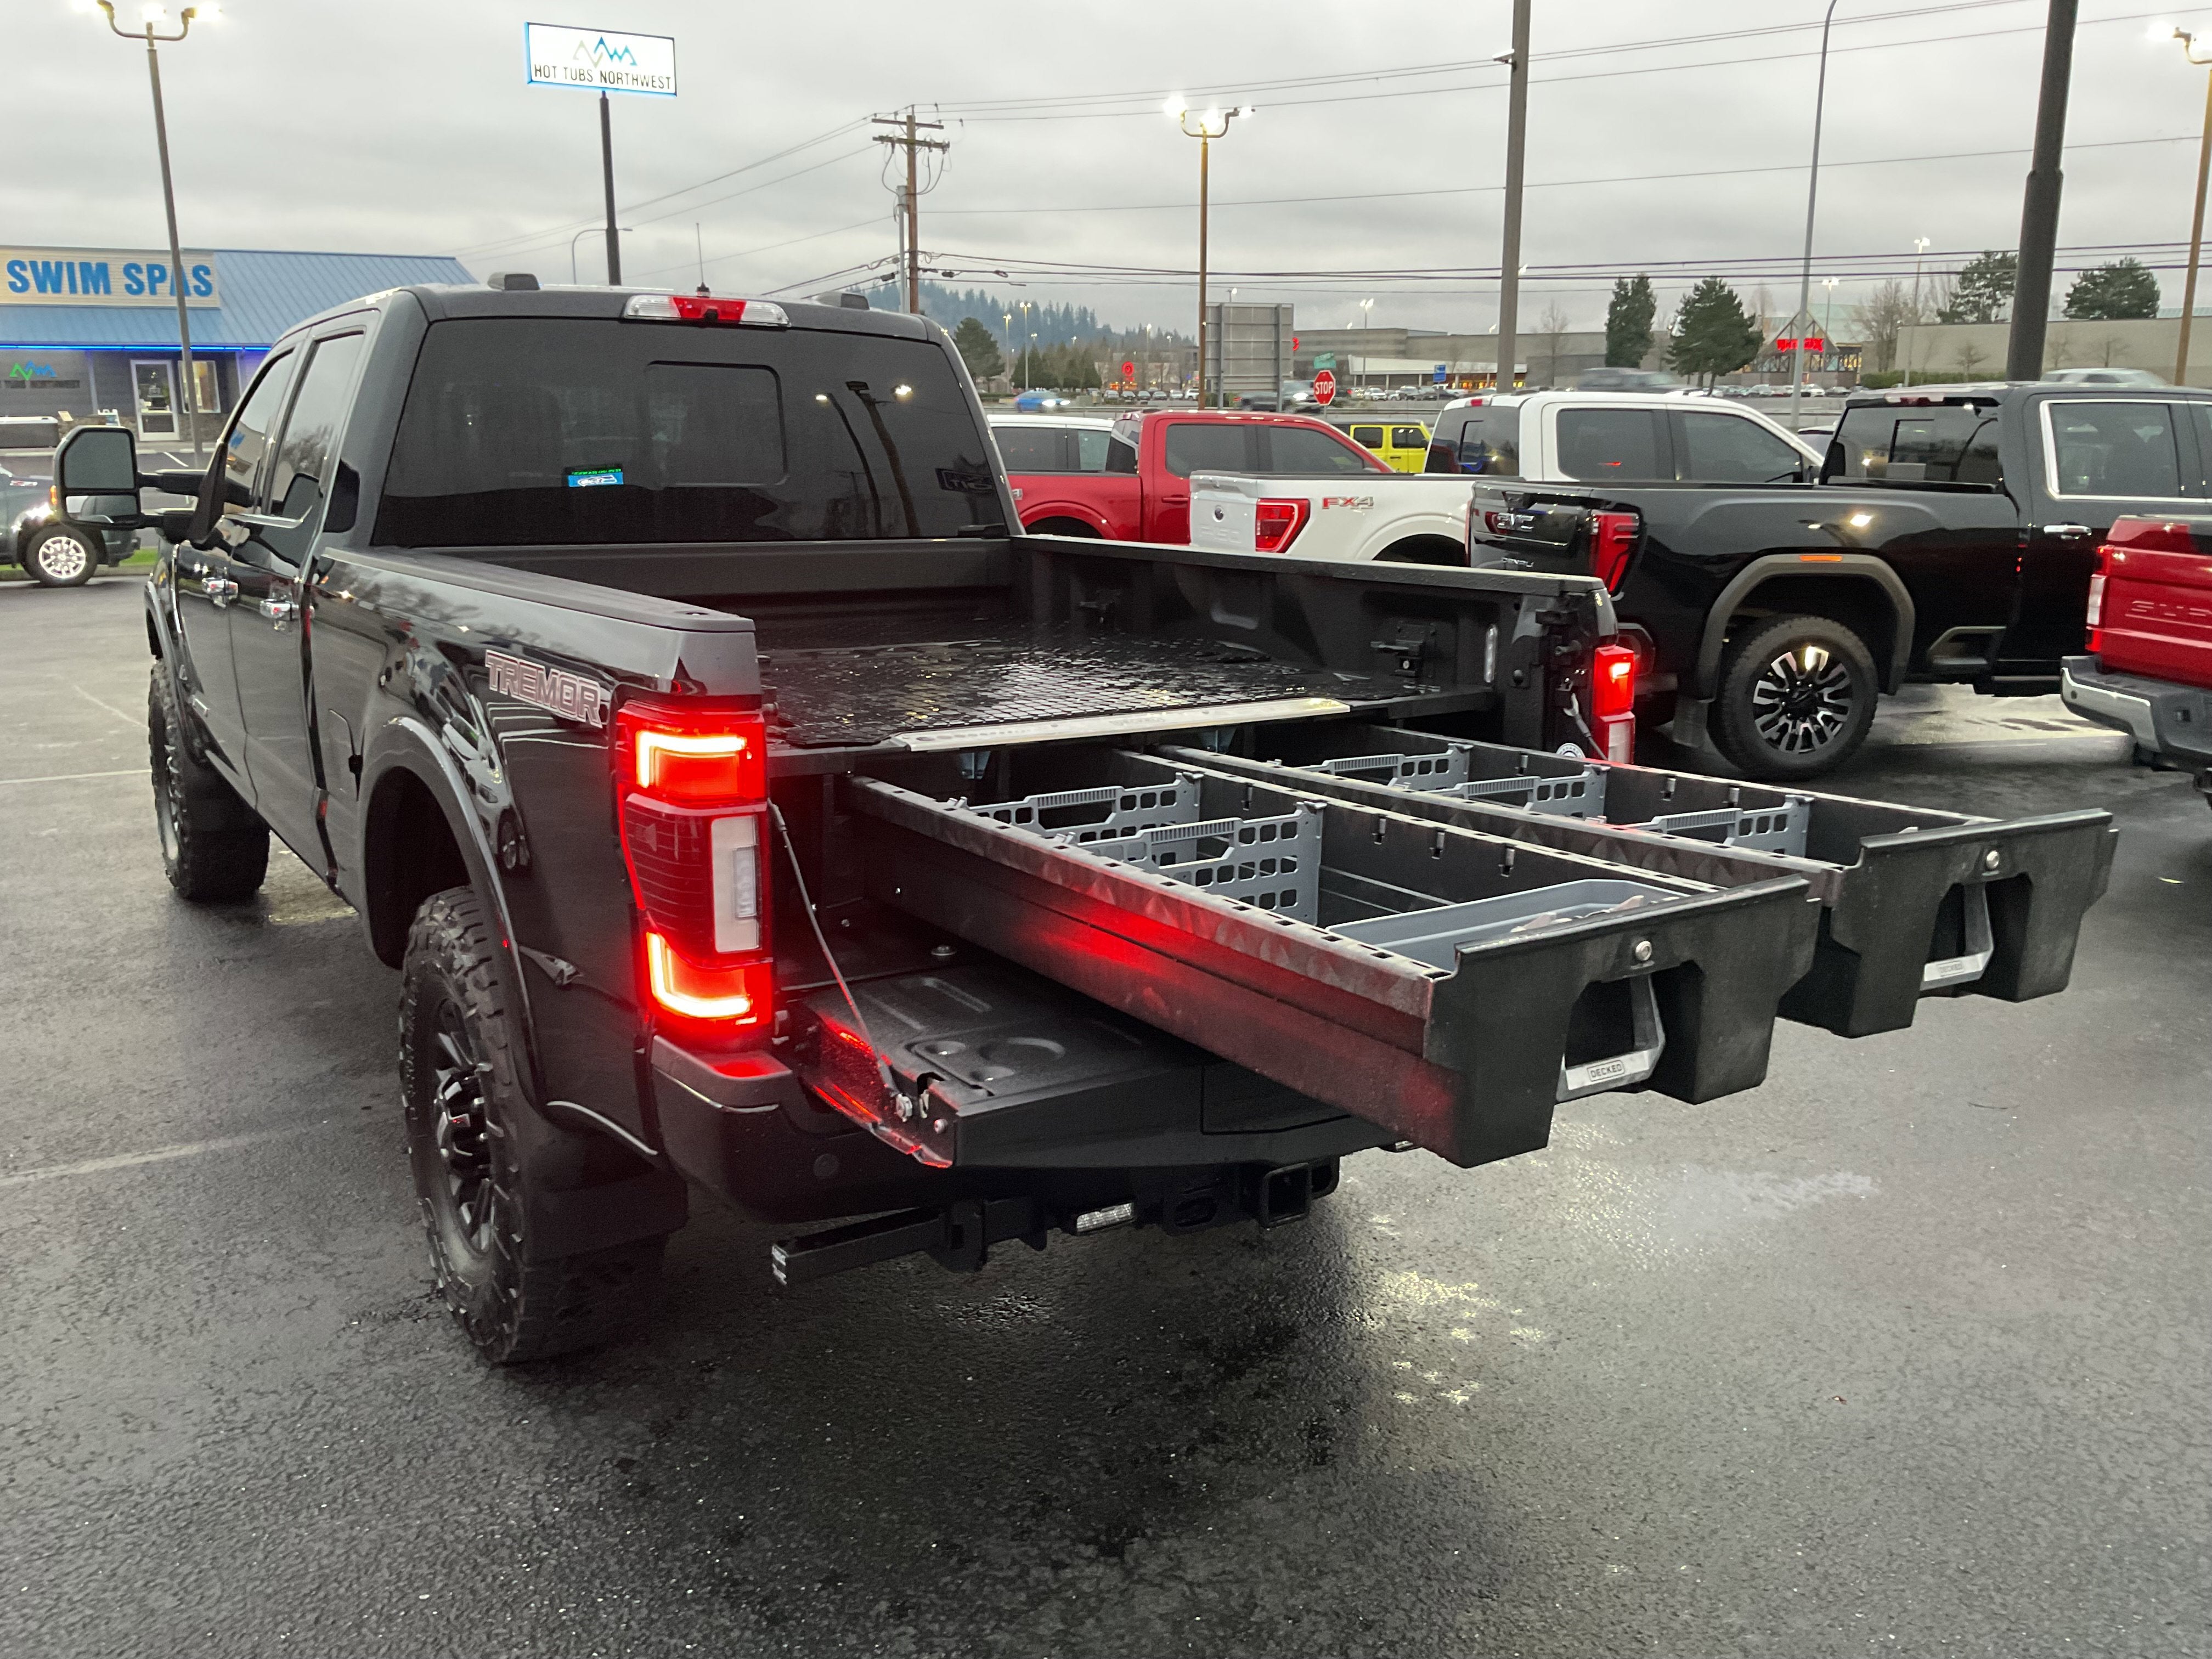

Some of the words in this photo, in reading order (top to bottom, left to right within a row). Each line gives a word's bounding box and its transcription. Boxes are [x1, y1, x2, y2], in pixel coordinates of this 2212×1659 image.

[534, 64, 557, 78] HOT
[563, 66, 593, 82] TUBS
[600, 70, 672, 90] NORTHWEST
[7, 259, 112, 295] SWIM
[1315, 381, 1333, 395] STOP
[1322, 496, 1374, 509] FX4
[485, 650, 602, 728] TREMOR
[1589, 1063, 1622, 1078] DECKED
